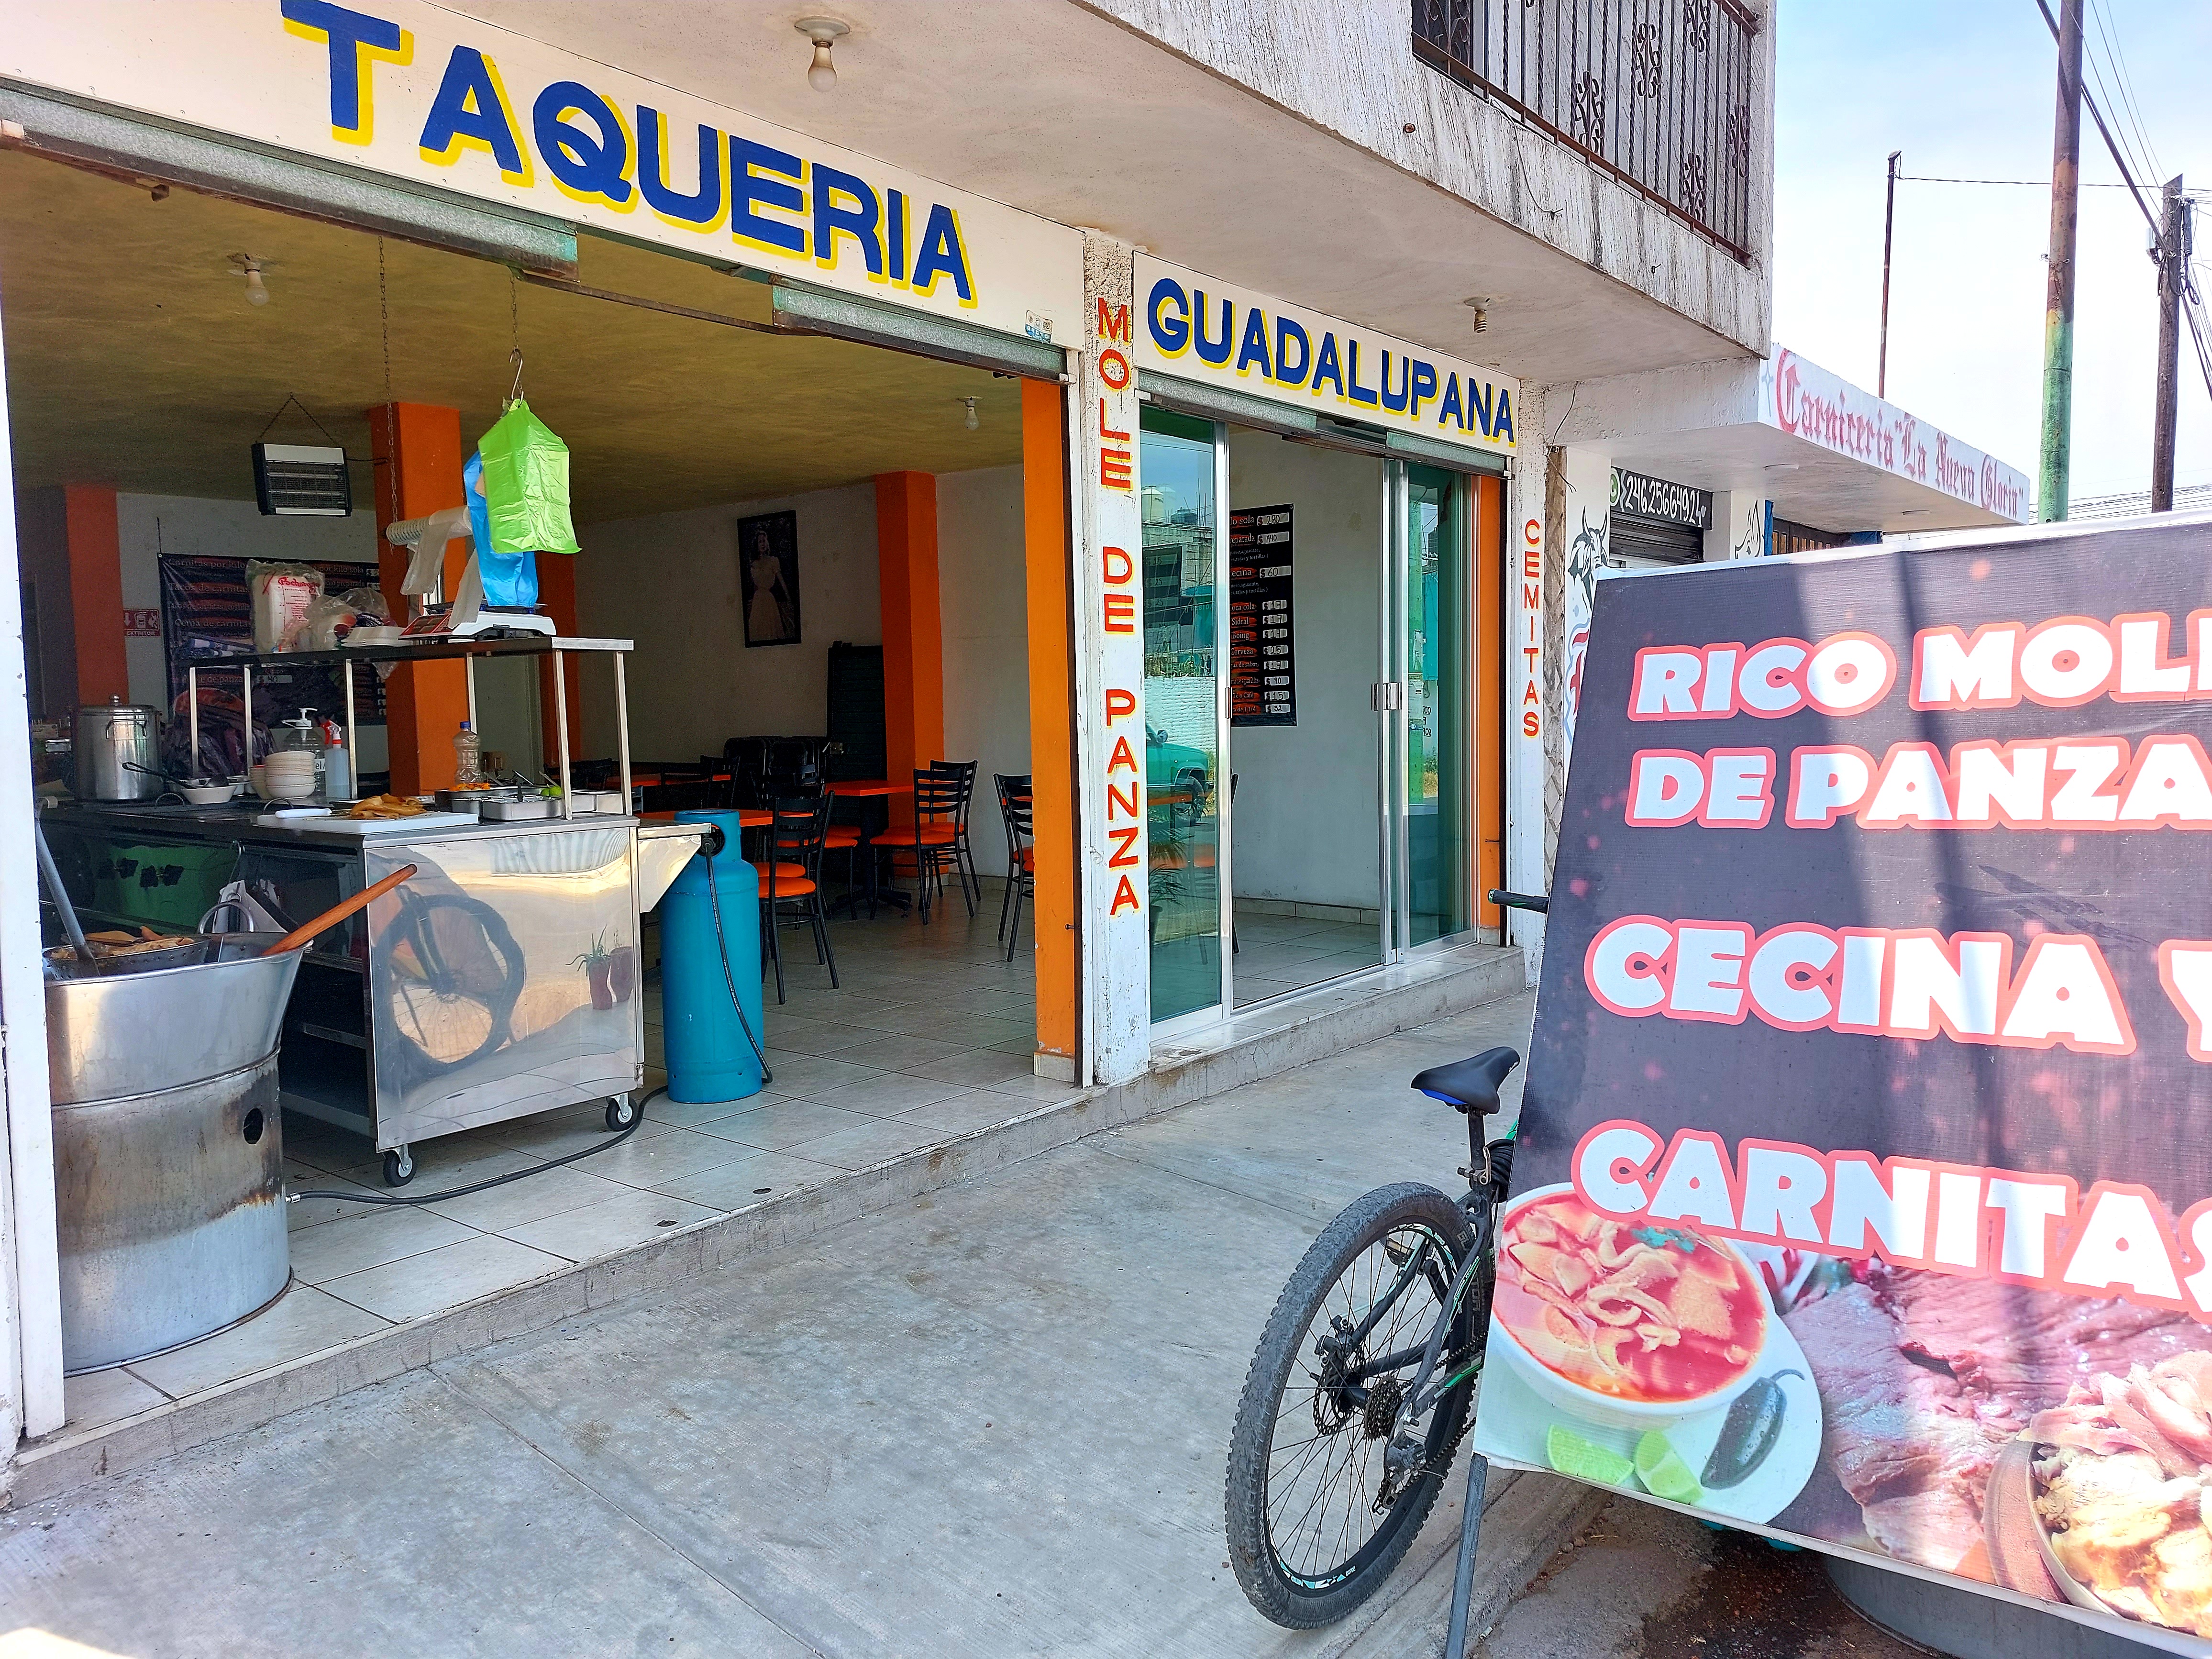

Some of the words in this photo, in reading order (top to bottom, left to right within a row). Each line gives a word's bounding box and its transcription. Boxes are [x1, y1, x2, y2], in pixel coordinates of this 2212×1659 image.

[281, 0, 977, 309] TAQUERIA
[1147, 277, 1516, 448] GUADALUPANA
[1097, 296, 1132, 491] MOLE
[1777, 349, 1894, 471] Carniceria
[1935, 431, 1975, 503] Nueva
[1230, 532, 1255, 545] reparada
[1239, 515, 1255, 525] sola
[1266, 515, 1280, 525] 280
[198, 584, 209, 592] de
[1102, 545, 1136, 635] DE
[1231, 568, 1252, 577] ecina
[1268, 567, 1278, 577] 60
[1232, 616, 1249, 626] Sidral
[1271, 614, 1282, 624] 17
[1243, 602, 1255, 611] cola
[1271, 601, 1281, 610] 17
[1523, 518, 1544, 739] CEMITAS
[1230, 647, 1253, 655] Cerveza
[1271, 645, 1282, 654] 25
[1232, 631, 1250, 641] Boing
[1271, 629, 1281, 638] 17
[1271, 661, 1281, 669] 17
[1629, 633, 1895, 719] RICO
[1911, 614, 2212, 710] MOL
[1272, 692, 1283, 700] 15
[1106, 688, 1140, 918] PANZA
[1626, 749, 1775, 828] DE
[1787, 735, 2212, 830] PANZA
[1585, 916, 2135, 1054] CECINA
